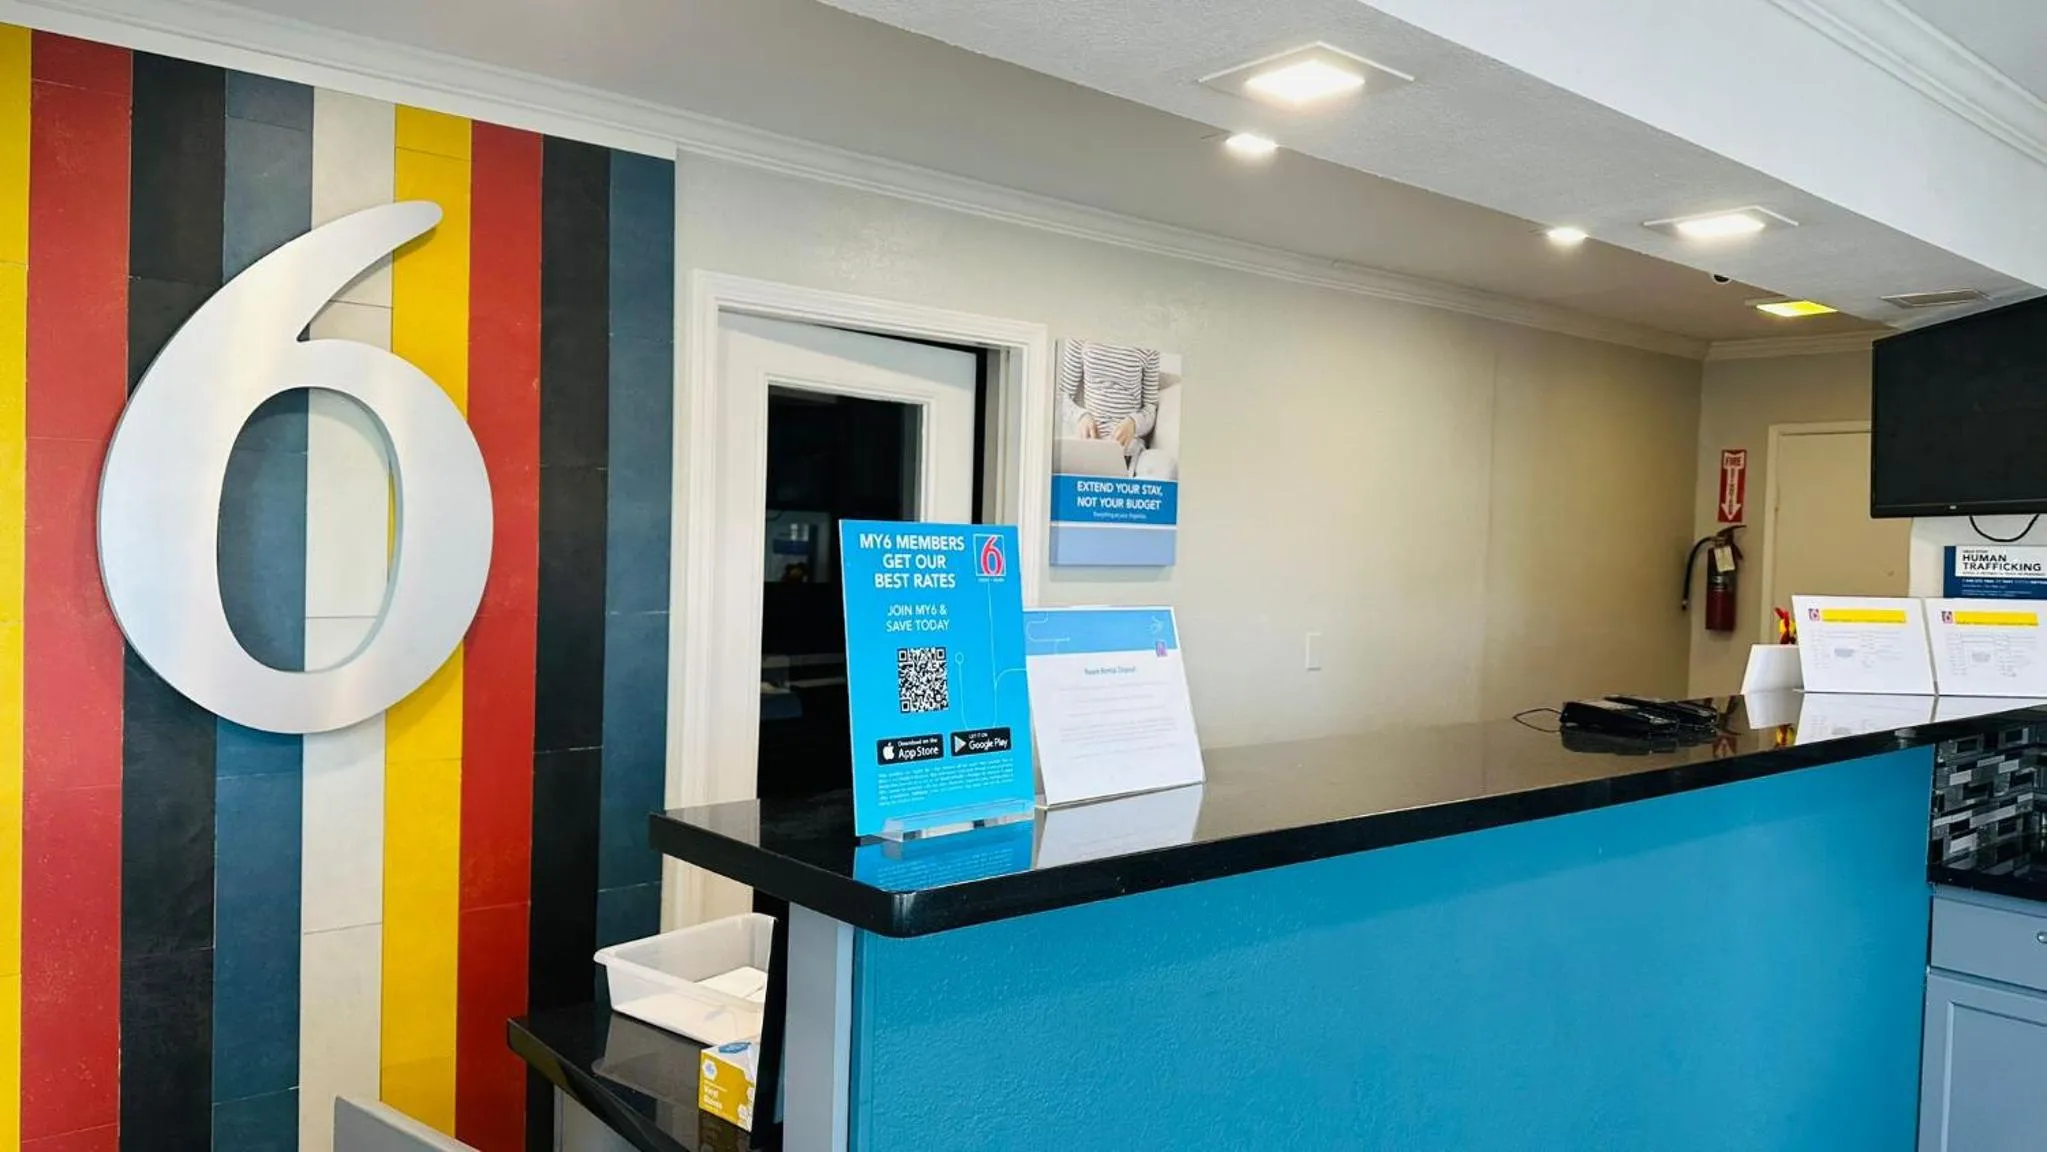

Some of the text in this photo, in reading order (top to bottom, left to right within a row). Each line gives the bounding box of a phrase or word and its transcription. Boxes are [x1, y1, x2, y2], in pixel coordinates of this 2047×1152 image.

[97, 200, 493, 733] 6
[1725, 456, 1742, 467] FIRE
[1077, 481, 1163, 496] EXTEND YOUR STAY,
[1077, 497, 1162, 510] NOT YOUR BUDGET
[859, 534, 965, 551] MY6 MEMBERS
[883, 554, 946, 569] GET OUR
[980, 535, 1005, 576] 6
[1963, 554, 2007, 562] HUMAN
[1963, 562, 2042, 571] TRAFFICKING
[875, 573, 956, 588] BEST RATES
[888, 605, 947, 616] JOIN MY6 &
[886, 619, 950, 632] SAVE TODAY
[968, 737, 1008, 751] Google Play
[899, 746, 939, 760] App Store
